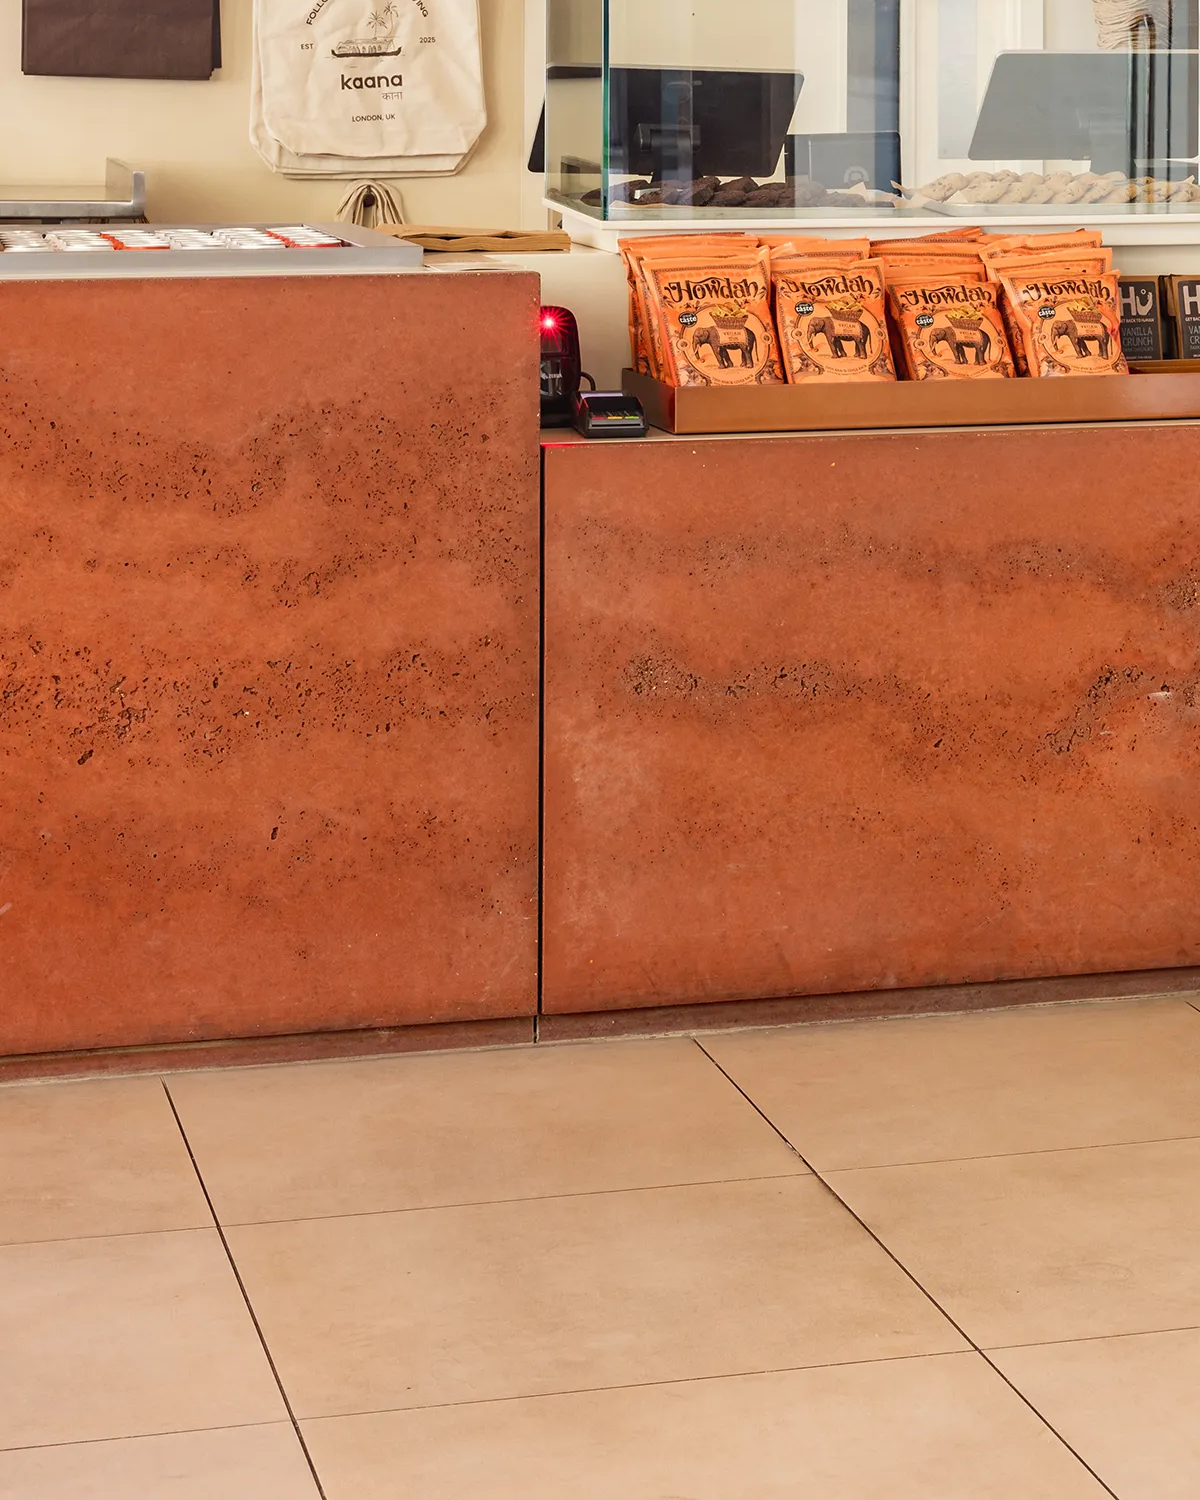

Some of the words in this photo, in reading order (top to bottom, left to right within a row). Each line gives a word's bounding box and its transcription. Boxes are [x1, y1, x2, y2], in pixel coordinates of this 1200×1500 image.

[419, 36, 436, 44] 2025
[340, 74, 403, 90] kaana
[352, 114, 384, 122] LONDON,
[664, 276, 760, 303] Howdah
[900, 284, 993, 306] Howdah
[1022, 278, 1112, 302] Howdah
[1121, 326, 1153, 336] VANILLA
[1122, 336, 1153, 346] CRUNCH
